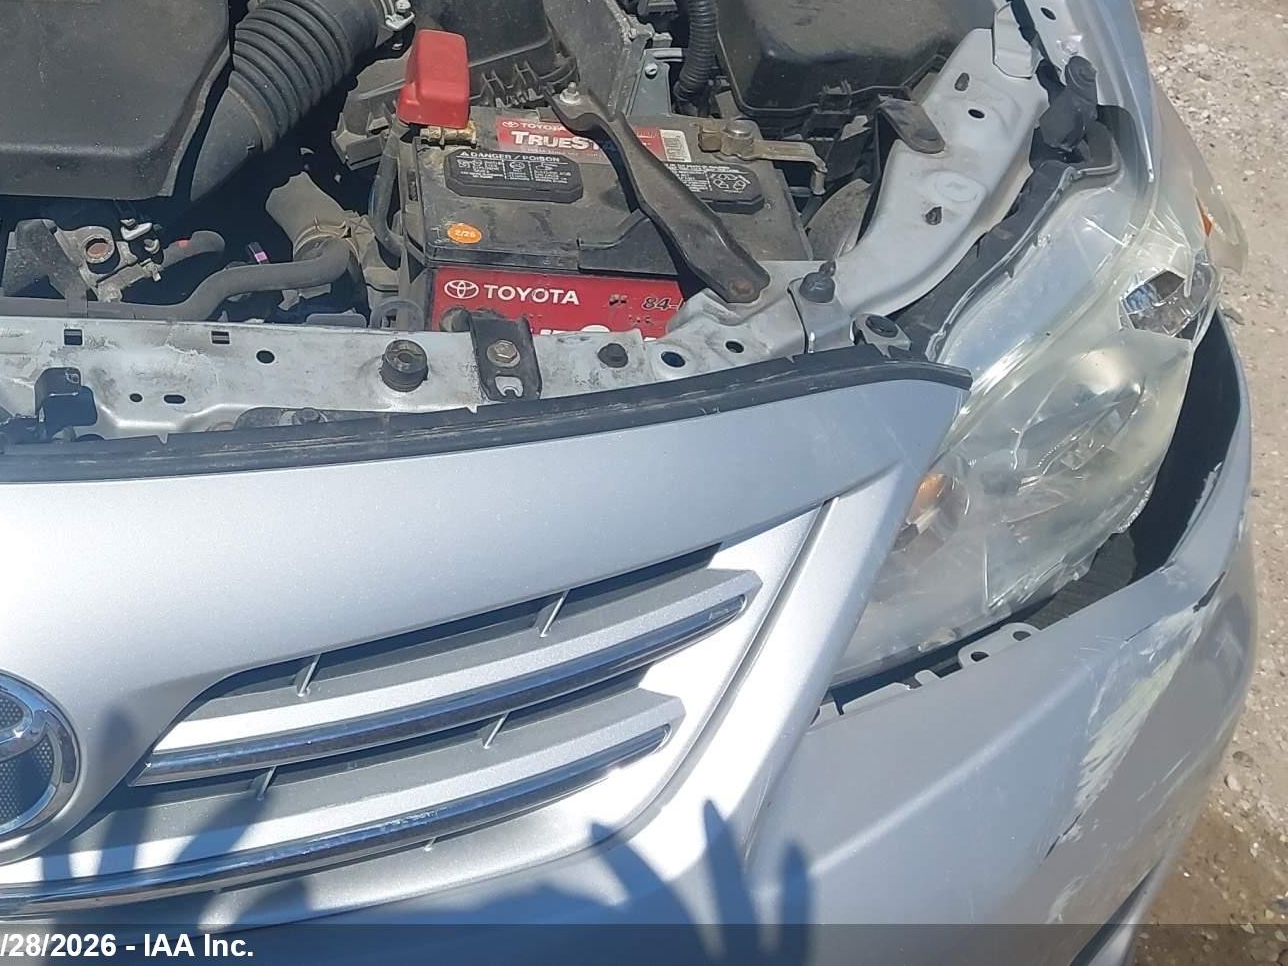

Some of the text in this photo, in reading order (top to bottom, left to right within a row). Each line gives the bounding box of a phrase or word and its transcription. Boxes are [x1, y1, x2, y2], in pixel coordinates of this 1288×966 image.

[521, 122, 567, 132] TOYOTA
[471, 152, 512, 161] DANGER
[522, 155, 560, 163] POISON
[484, 284, 580, 305] TOYOTA
